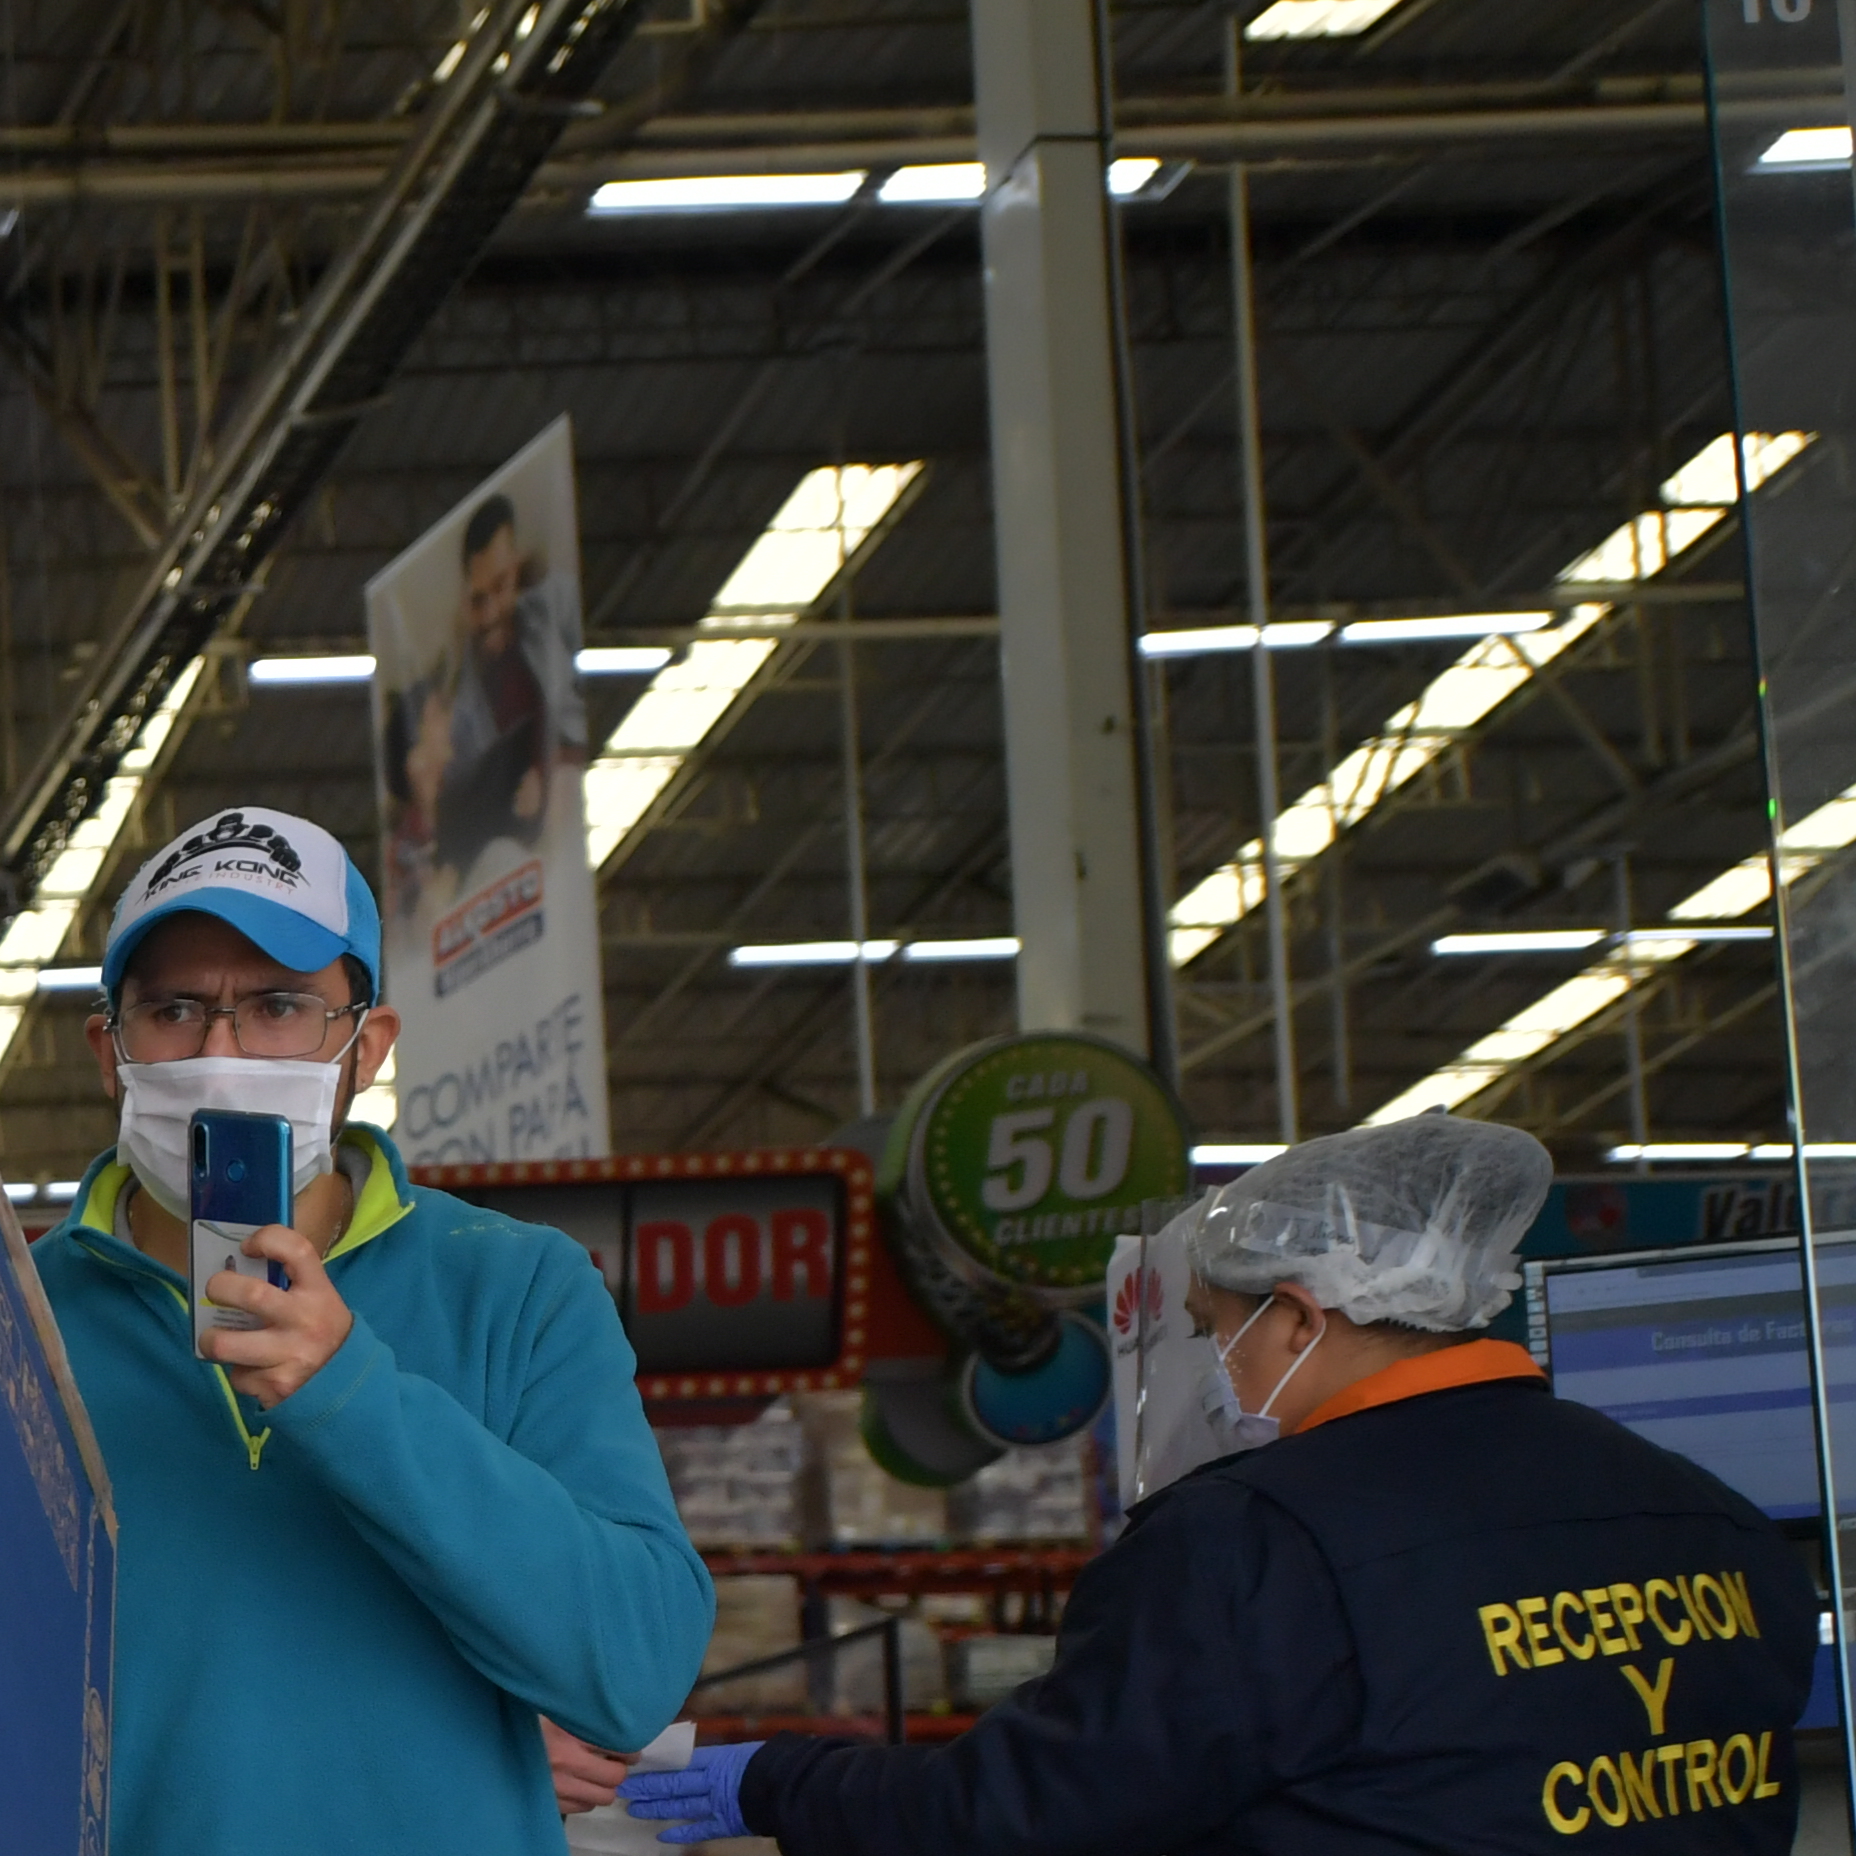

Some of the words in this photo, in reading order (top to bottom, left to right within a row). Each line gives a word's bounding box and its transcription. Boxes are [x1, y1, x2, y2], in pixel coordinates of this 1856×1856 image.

[214, 860, 299, 888] KONG
[1006, 1070, 1089, 1100] CADA
[981, 1096, 1134, 1213] 50
[1651, 1329, 1732, 1354] Consulta
[1737, 1324, 1760, 1342] de
[1479, 1570, 1760, 1677] RECEPCION
[1620, 1657, 1675, 1736] Y
[1541, 1731, 1781, 1836] CONTROL
